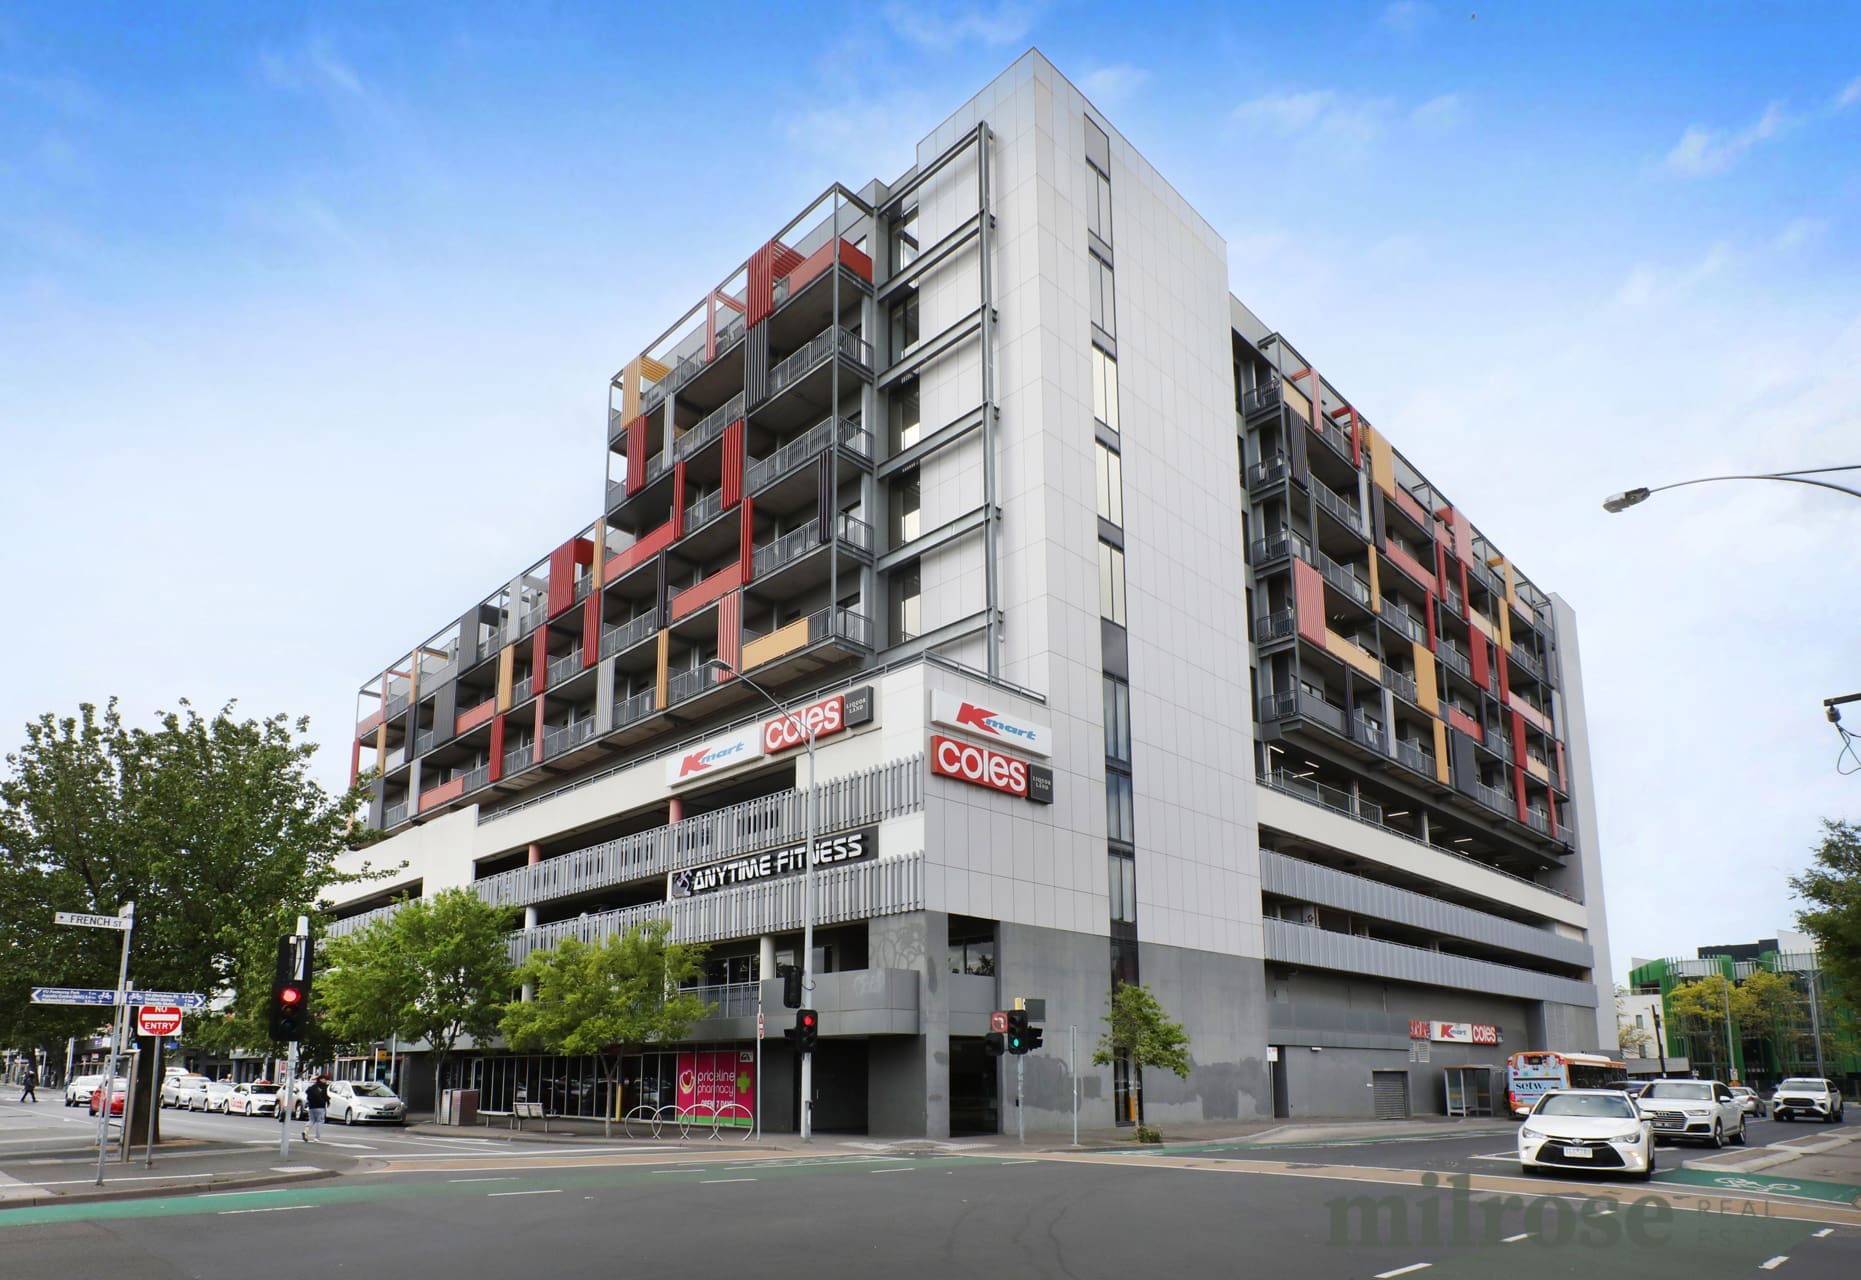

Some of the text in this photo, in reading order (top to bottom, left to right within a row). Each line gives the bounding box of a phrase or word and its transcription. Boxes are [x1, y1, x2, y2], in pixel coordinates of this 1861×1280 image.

[846, 697, 866, 710] LIQUOR
[849, 704, 864, 714] LAND
[765, 700, 841, 749] coles
[956, 702, 1037, 740] Kmart
[678, 741, 745, 777] Kmart
[938, 740, 1026, 792] coles
[692, 855, 771, 891] ANYTIME
[70, 914, 123, 928] FRENCH ST
[144, 1022, 176, 1030] ENTRY
[1440, 1023, 1467, 1039] Kmart
[1472, 1024, 1496, 1044] coles
[697, 1069, 735, 1084] priceline
[697, 1084, 734, 1097] pharmacy
